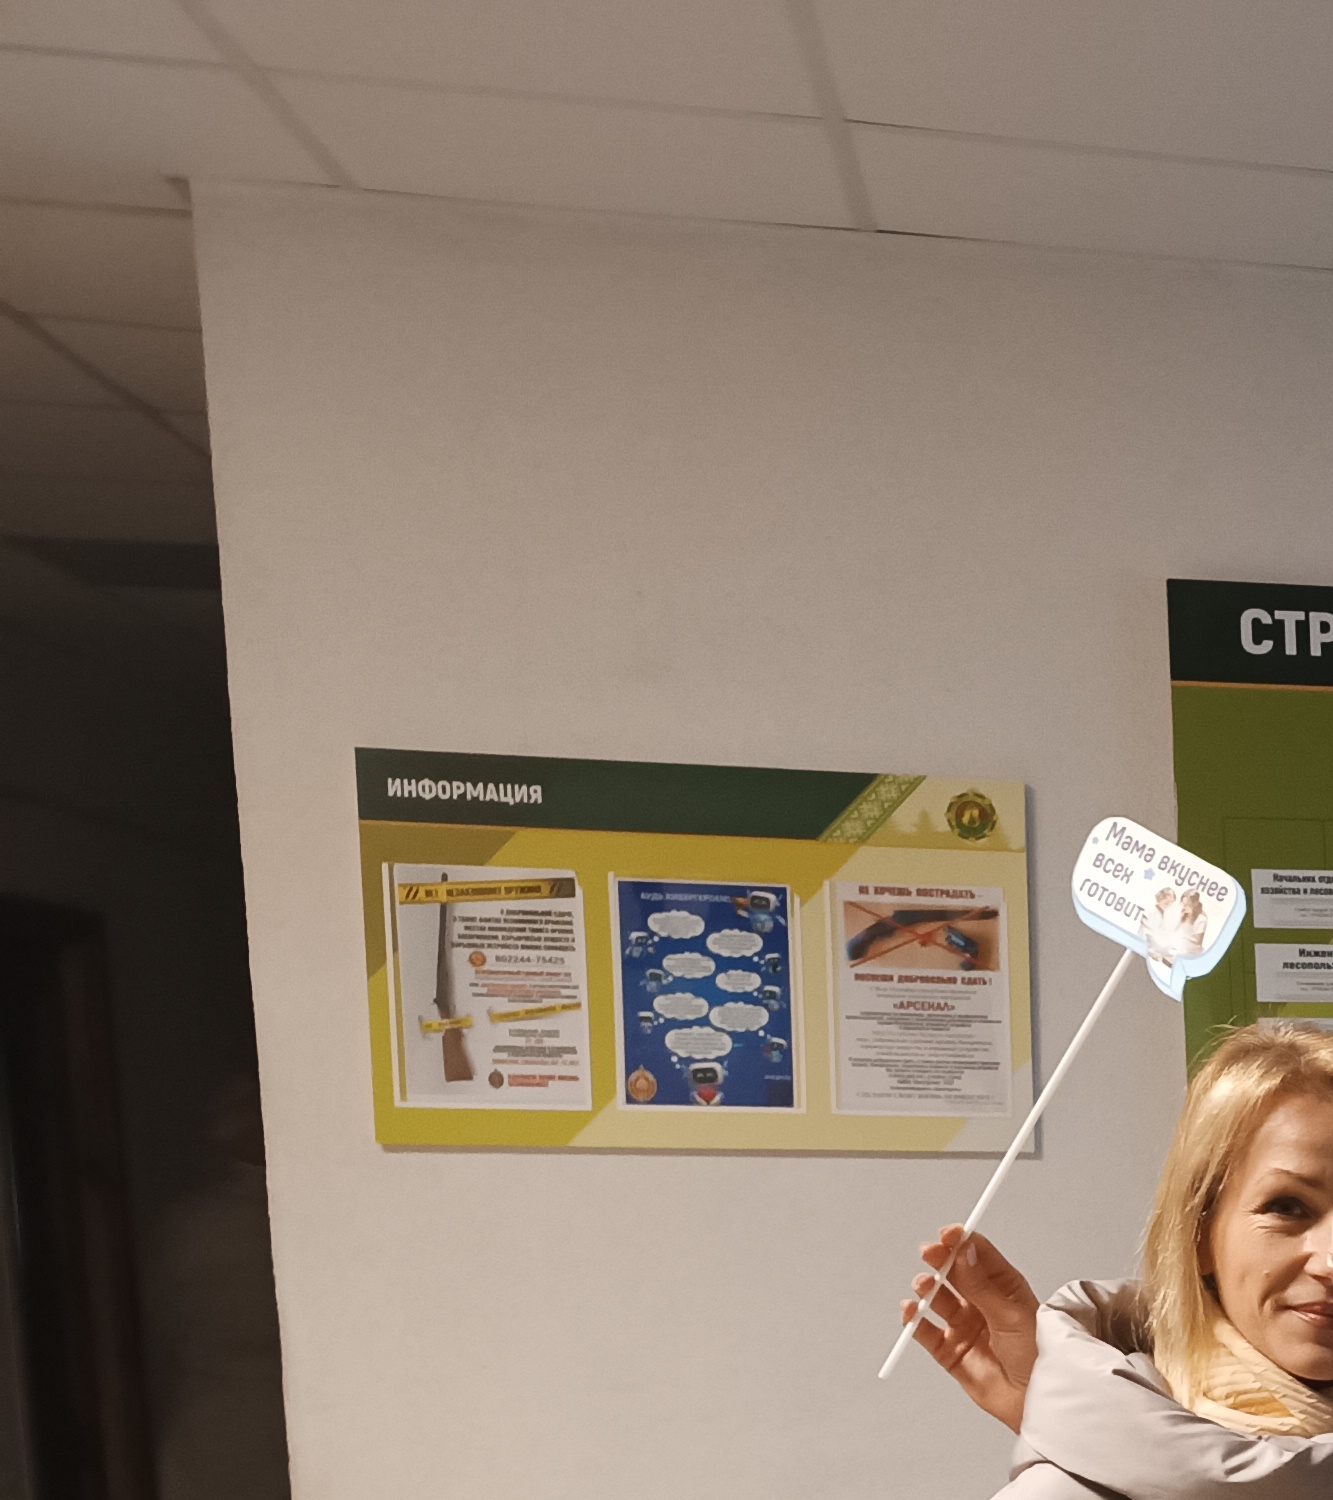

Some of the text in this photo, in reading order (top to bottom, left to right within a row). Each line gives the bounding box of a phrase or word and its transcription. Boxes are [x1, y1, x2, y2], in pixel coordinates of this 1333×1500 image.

[387, 777, 543, 806] ИНФОРМАЦИЯ
[1092, 852, 1135, 884] всех
[1105, 821, 1229, 902] Мама вкуснее
[1273, 873, 1316, 884] Начальник
[892, 1000, 956, 1011] «АРСЕНАЛ»
